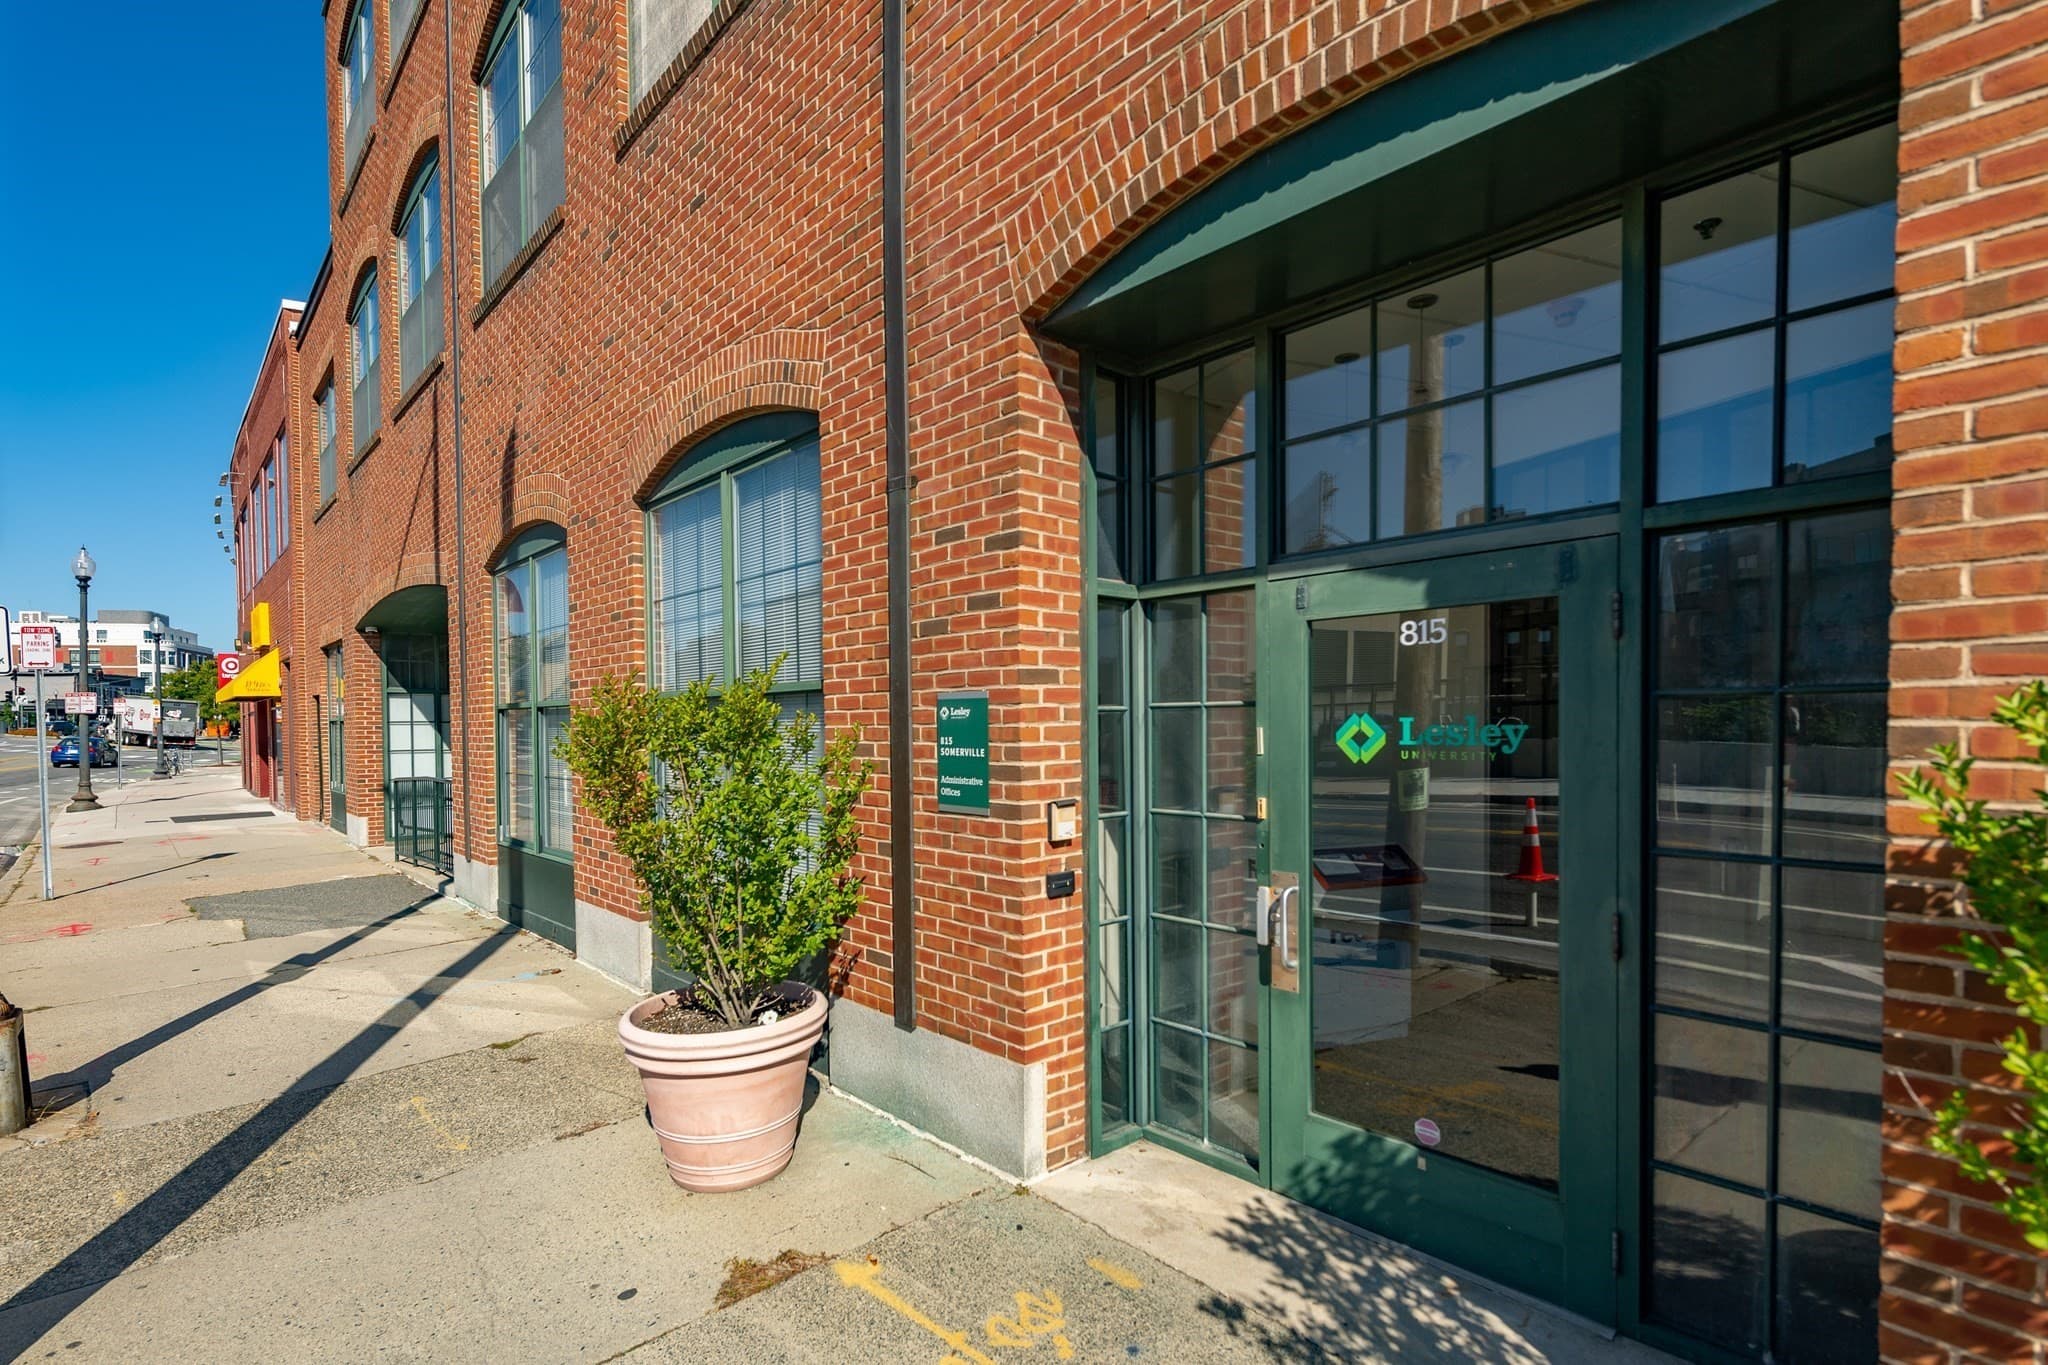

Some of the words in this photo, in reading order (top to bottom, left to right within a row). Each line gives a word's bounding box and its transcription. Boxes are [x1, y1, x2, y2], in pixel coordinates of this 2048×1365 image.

[1399, 617, 1448, 646] 815
[950, 706, 971, 717] Lesley
[1398, 713, 1529, 754] Lesley
[940, 736, 952, 745] 815
[940, 747, 984, 757] SOMERVILLE
[1400, 749, 1497, 761] UNIVERSITY
[940, 775, 983, 786] Administrative
[940, 787, 960, 796] Offices
